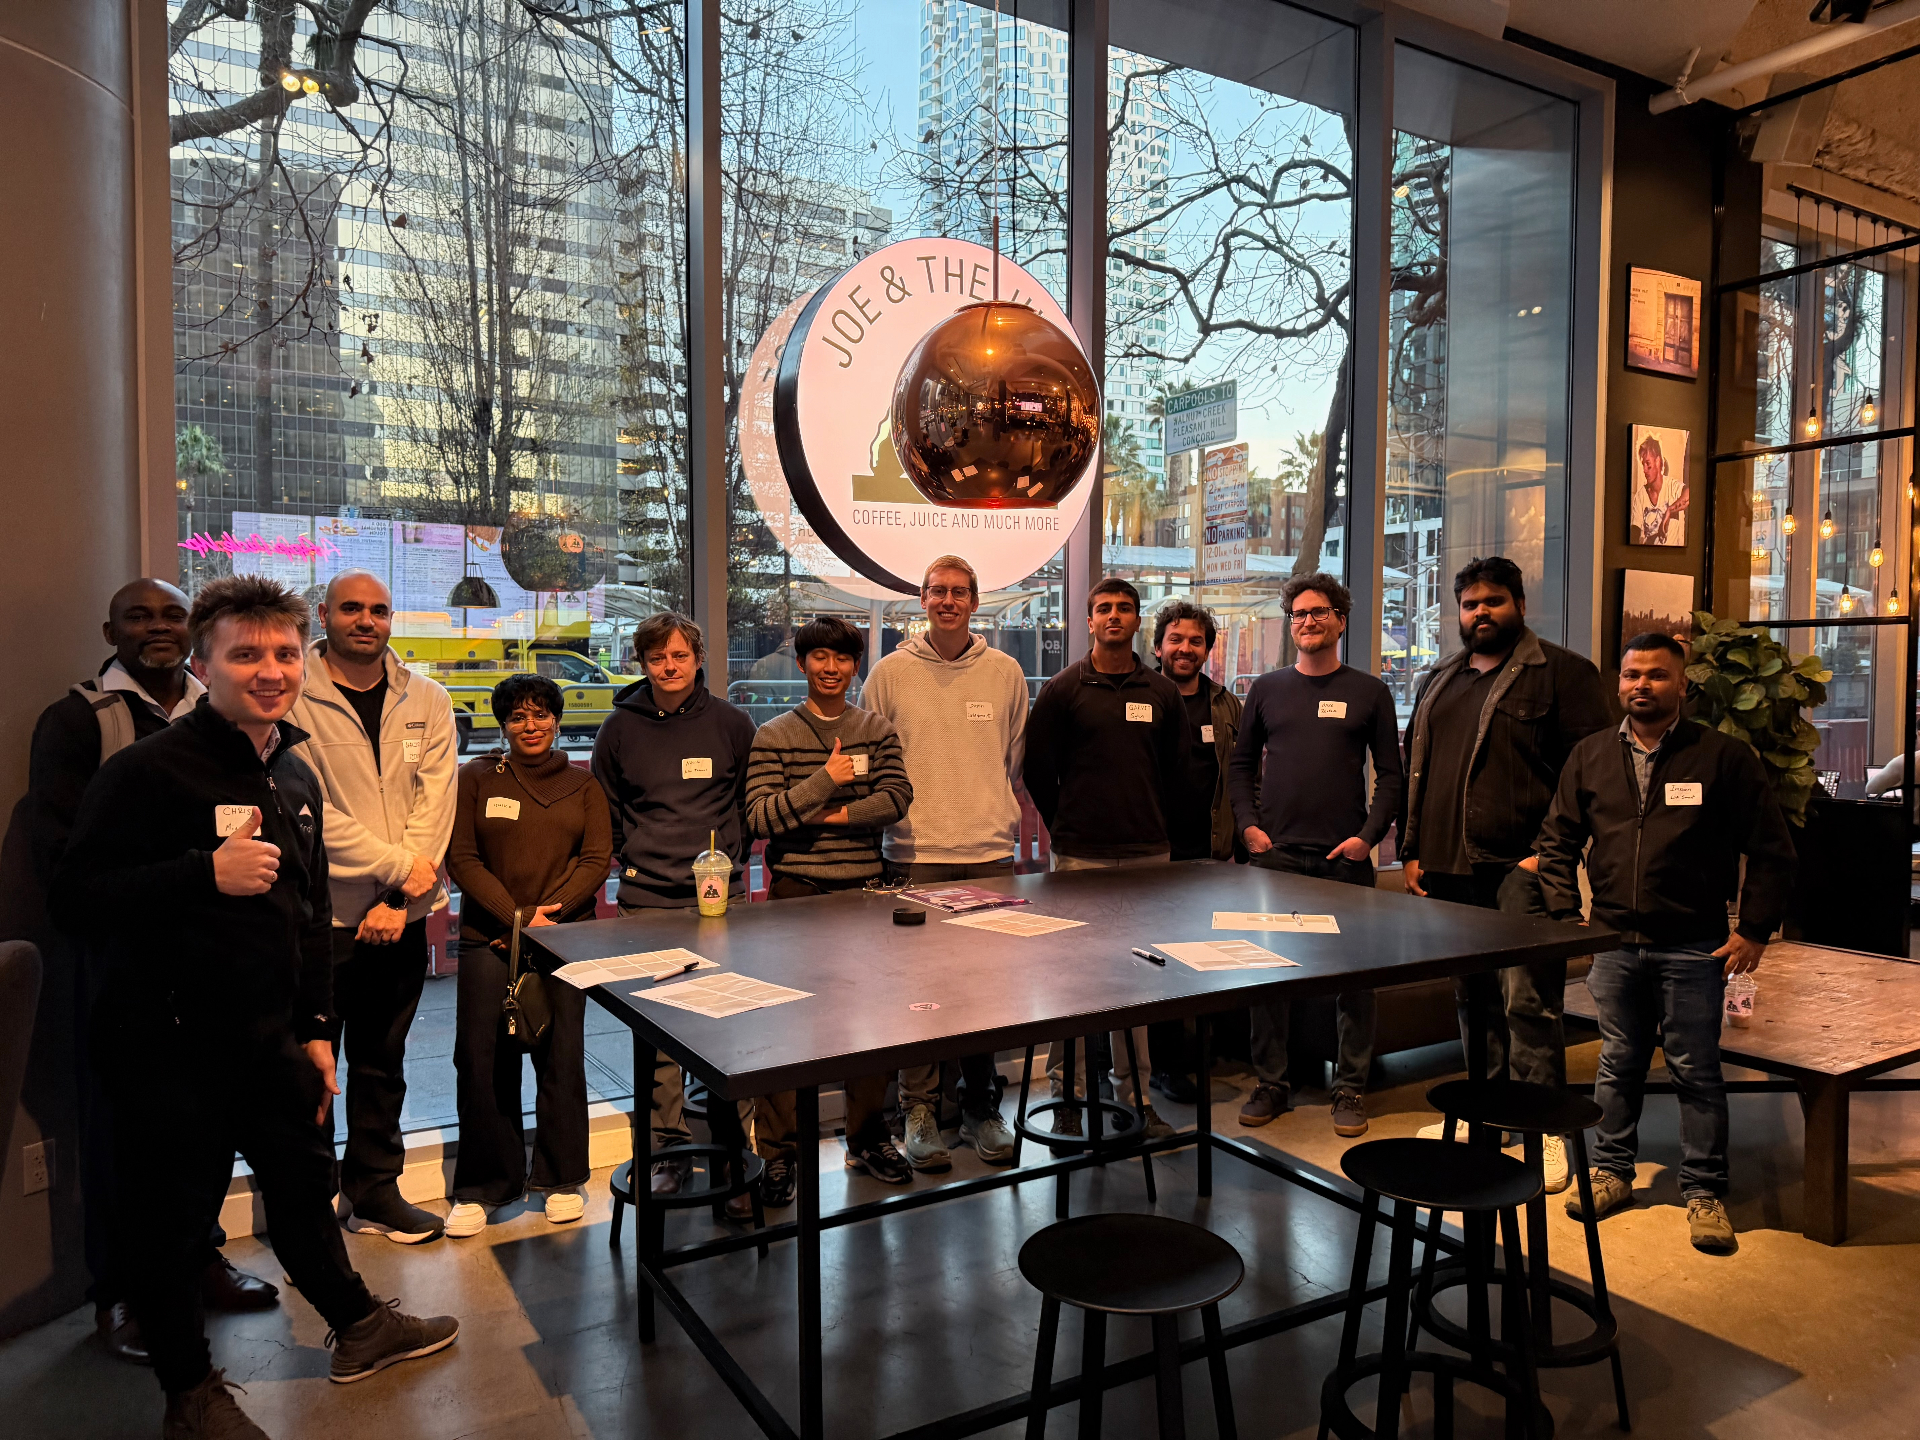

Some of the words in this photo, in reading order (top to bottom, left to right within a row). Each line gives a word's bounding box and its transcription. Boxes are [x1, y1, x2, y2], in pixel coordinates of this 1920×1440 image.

[821, 284, 883, 369] JOE
[879, 265, 913, 304] &
[916, 255, 990, 301] THE
[1167, 388, 1216, 413] CARPOOLS
[1221, 383, 1233, 399] TO
[1173, 410, 1199, 426] WALNUT
[1202, 403, 1227, 418] CREEK
[1173, 421, 1206, 438] PLEASANT
[1210, 415, 1227, 428] HILL
[1182, 430, 1216, 447] CONCORD
[1207, 467, 1218, 481] NO
[1219, 462, 1247, 478] STOPPING
[1225, 499, 1245, 509] CARPOOL
[852, 509, 907, 528] COFFEE,
[909, 511, 948, 528] JUICE
[951, 513, 979, 529] AND
[984, 514, 1021, 530] MUCH
[1025, 516, 1060, 531] MORE
[1206, 528, 1217, 544] NO
[1218, 526, 1245, 542] PARKING
[1206, 562, 1218, 573] MON
[1220, 560, 1232, 571] WED
[1234, 559, 1243, 569] FRI
[222, 806, 252, 816] CHRIS
